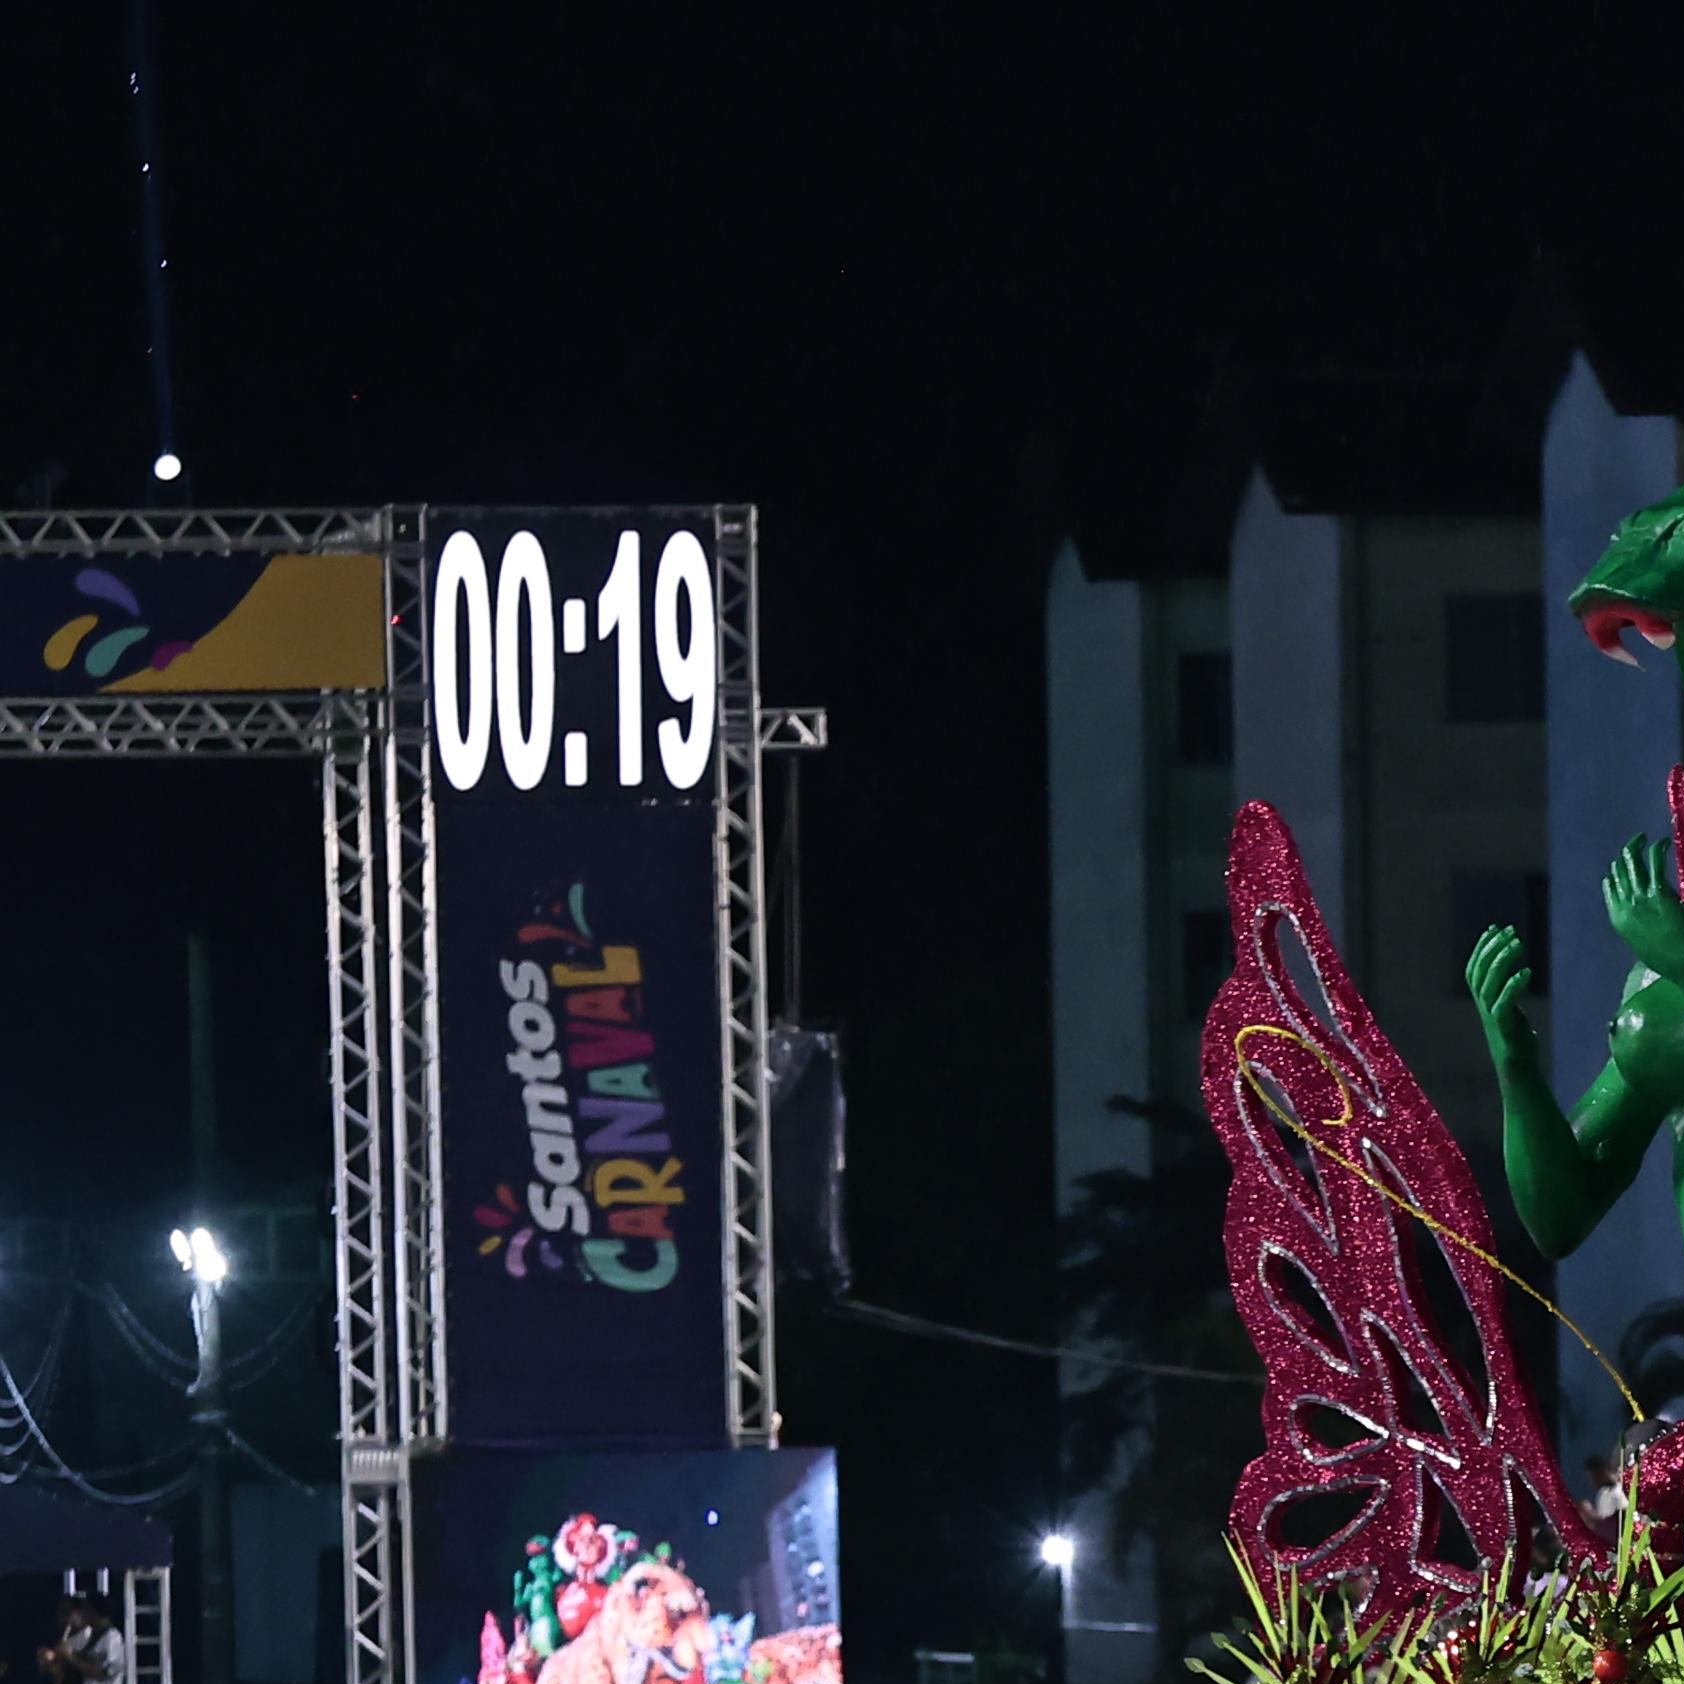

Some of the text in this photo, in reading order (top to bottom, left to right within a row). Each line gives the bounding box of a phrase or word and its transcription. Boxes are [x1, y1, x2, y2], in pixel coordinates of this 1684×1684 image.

[433, 529, 717, 791] 00:19
[500, 958, 591, 1237] Santos
[551, 944, 686, 1293] CARNAVAL
